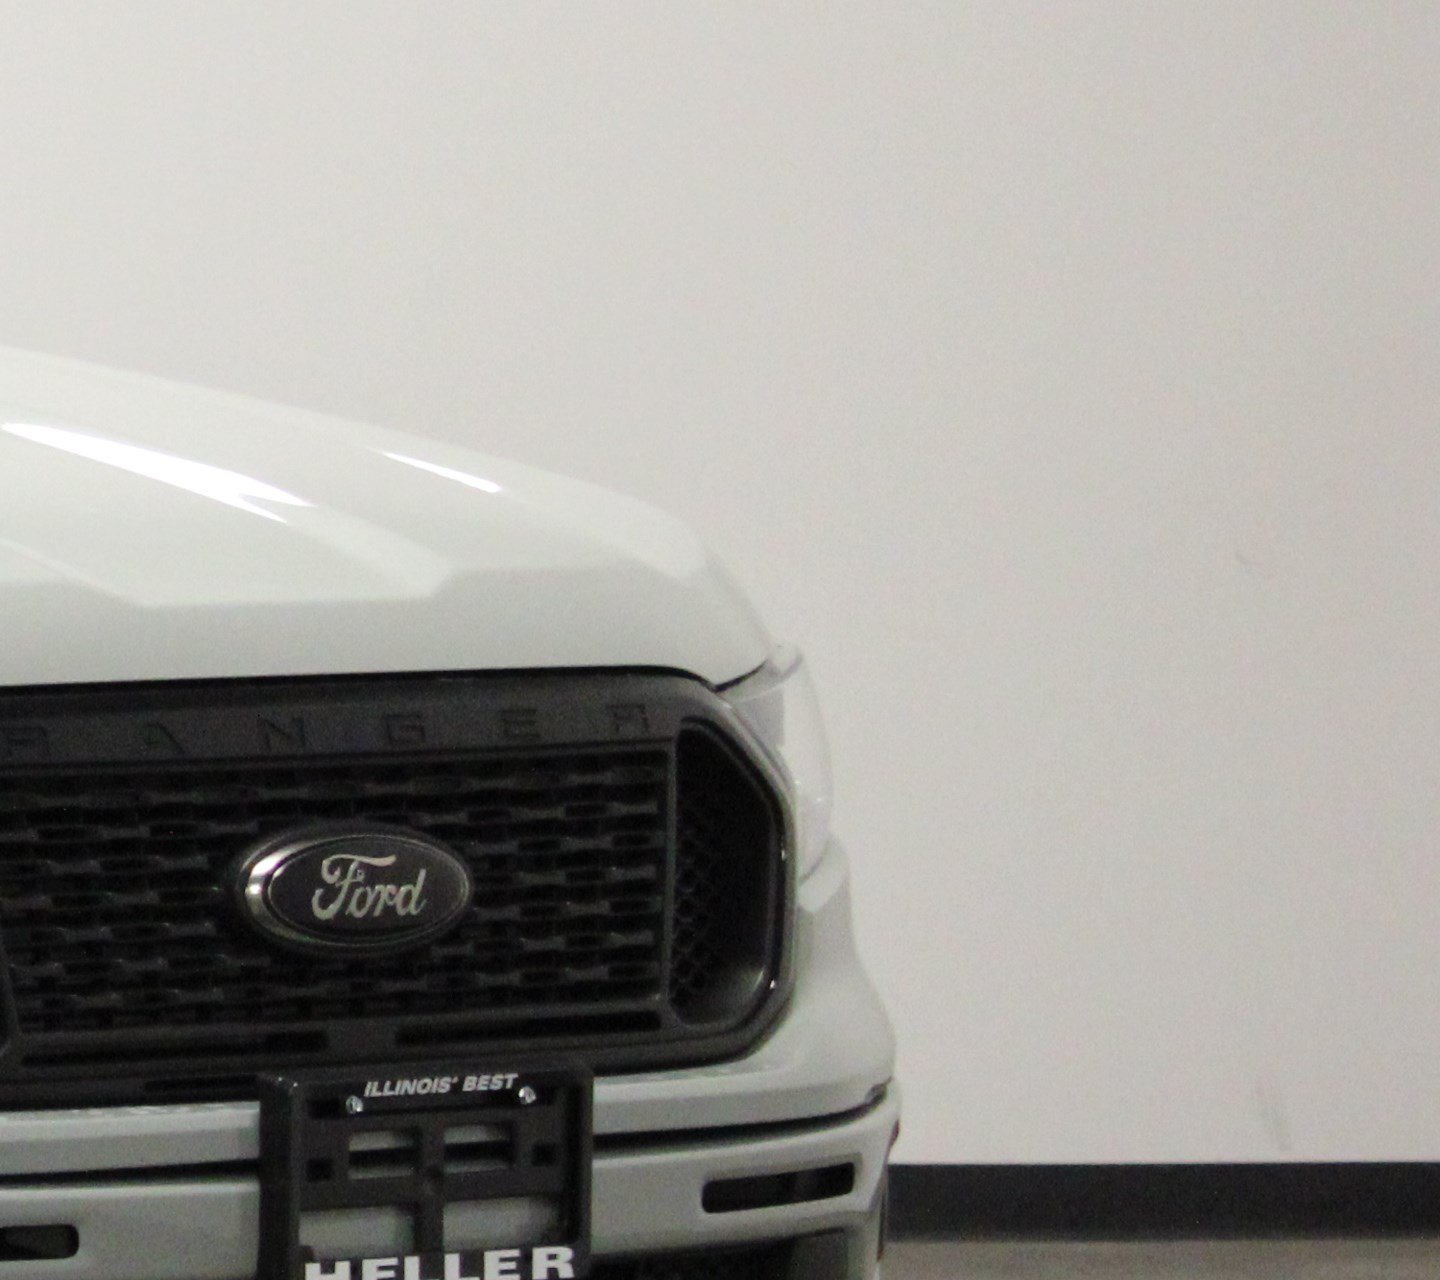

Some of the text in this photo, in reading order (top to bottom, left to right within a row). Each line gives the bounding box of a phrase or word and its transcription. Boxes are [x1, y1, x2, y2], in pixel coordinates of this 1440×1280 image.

[0, 703, 649, 757] RANGER
[311, 854, 427, 920] Ford
[364, 1073, 519, 1098] ILLINOIS' BEST
